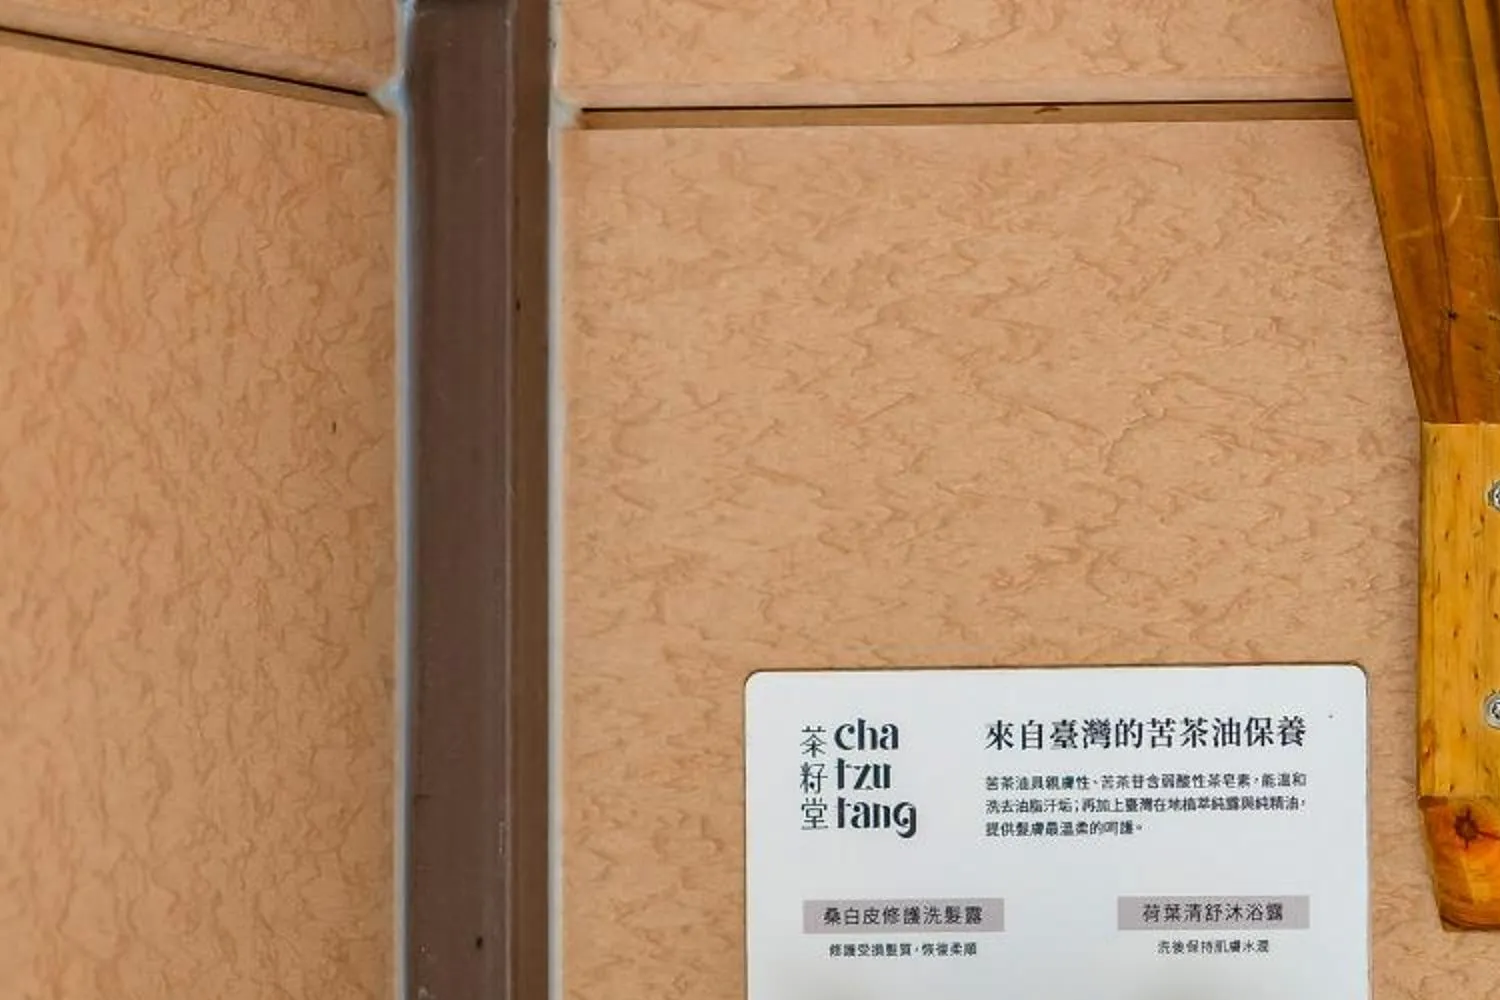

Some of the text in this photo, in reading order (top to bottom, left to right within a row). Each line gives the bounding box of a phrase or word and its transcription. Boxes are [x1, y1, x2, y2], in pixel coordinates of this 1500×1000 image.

[834, 717, 899, 751] cha
[985, 715, 1307, 751] 來自臺灣的苦茶油保養
[800, 725, 829, 830] 茶籽堂
[836, 757, 892, 790] tzu
[836, 796, 918, 839] tang
[823, 905, 983, 926] 桑白皮修護洗髮露
[1142, 903, 1284, 924] 荷葉清舒沐浴露
